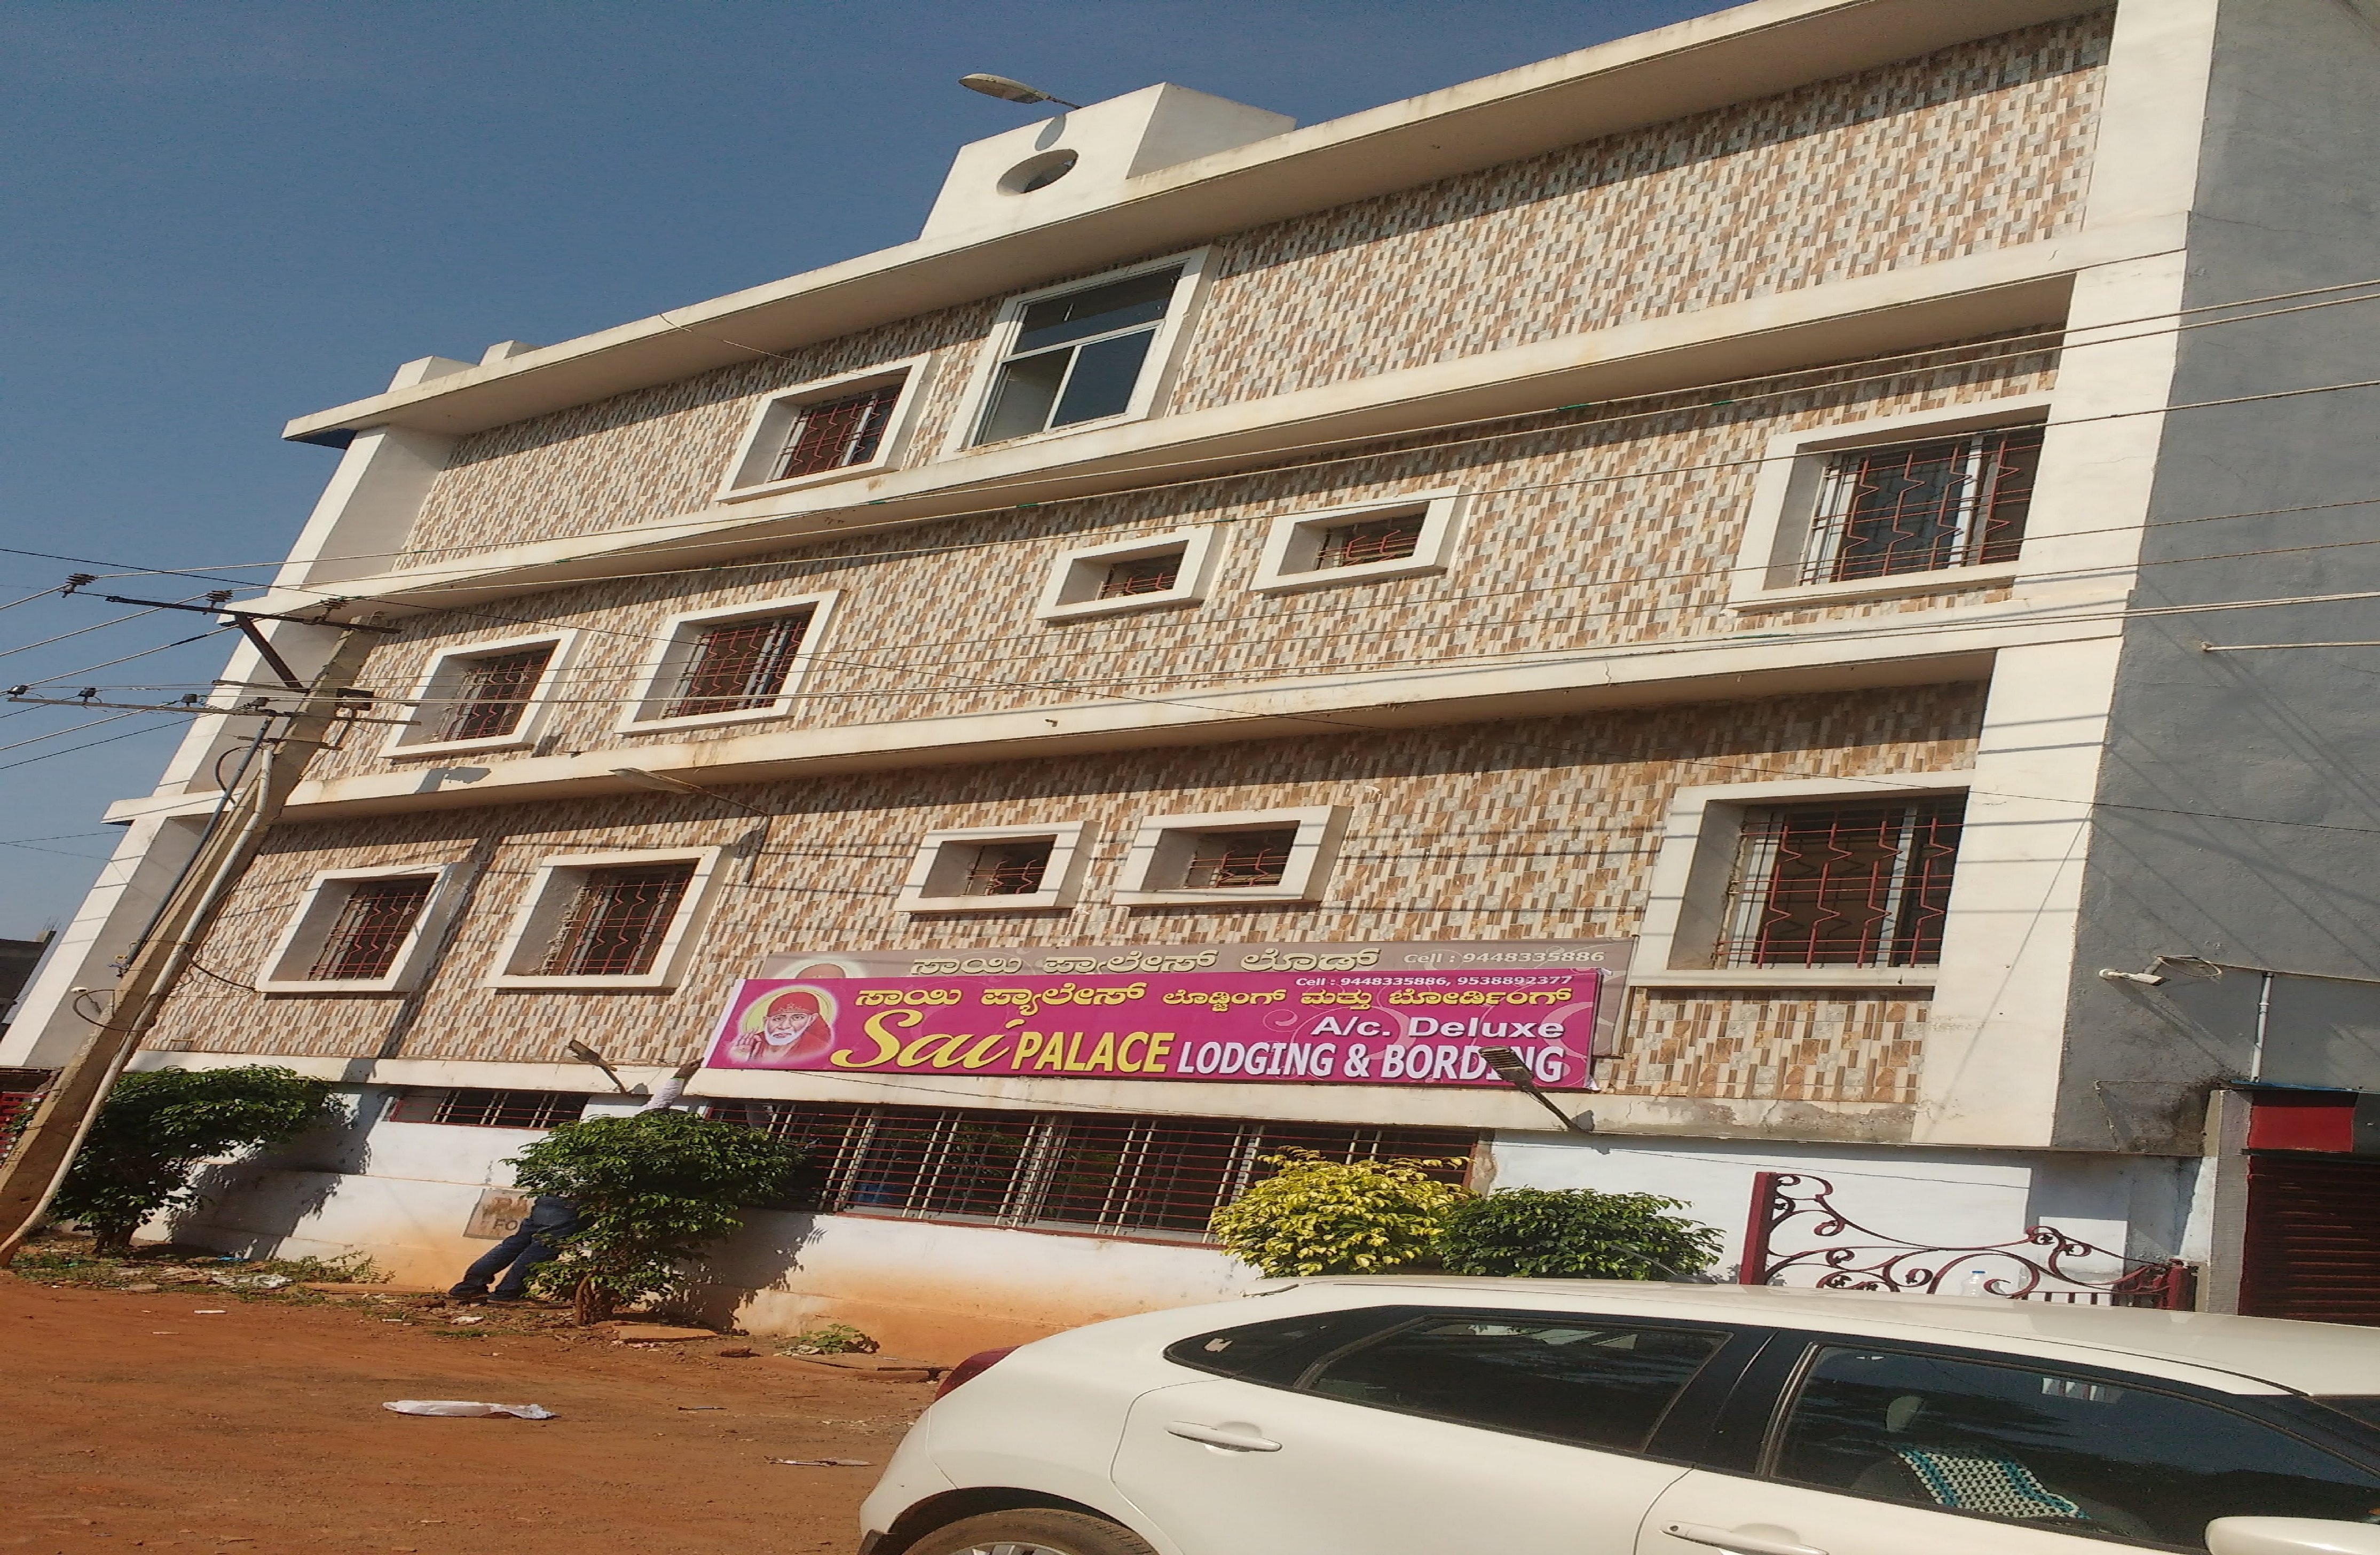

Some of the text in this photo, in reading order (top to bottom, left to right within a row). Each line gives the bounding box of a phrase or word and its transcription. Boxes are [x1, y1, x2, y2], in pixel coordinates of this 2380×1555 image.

[910, 957, 1023, 975] ಸಾಯಿ
[1404, 953, 1441, 963] Cell
[1463, 952, 1605, 963] 9448335886
[1296, 978, 1326, 986] Cell
[1457, 976, 1572, 985] 9538892377
[855, 989, 963, 1006] ಸಾಯಿ
[981, 982, 1147, 1016] ಪ್ಯಾಲೇಸ್
[1301, 988, 1372, 1010] ಮತ್ತು
[1310, 1016, 1564, 1038] A/c. Deluxe
[830, 1008, 1564, 1082] Sai PALACE LODGING & BORDNG
